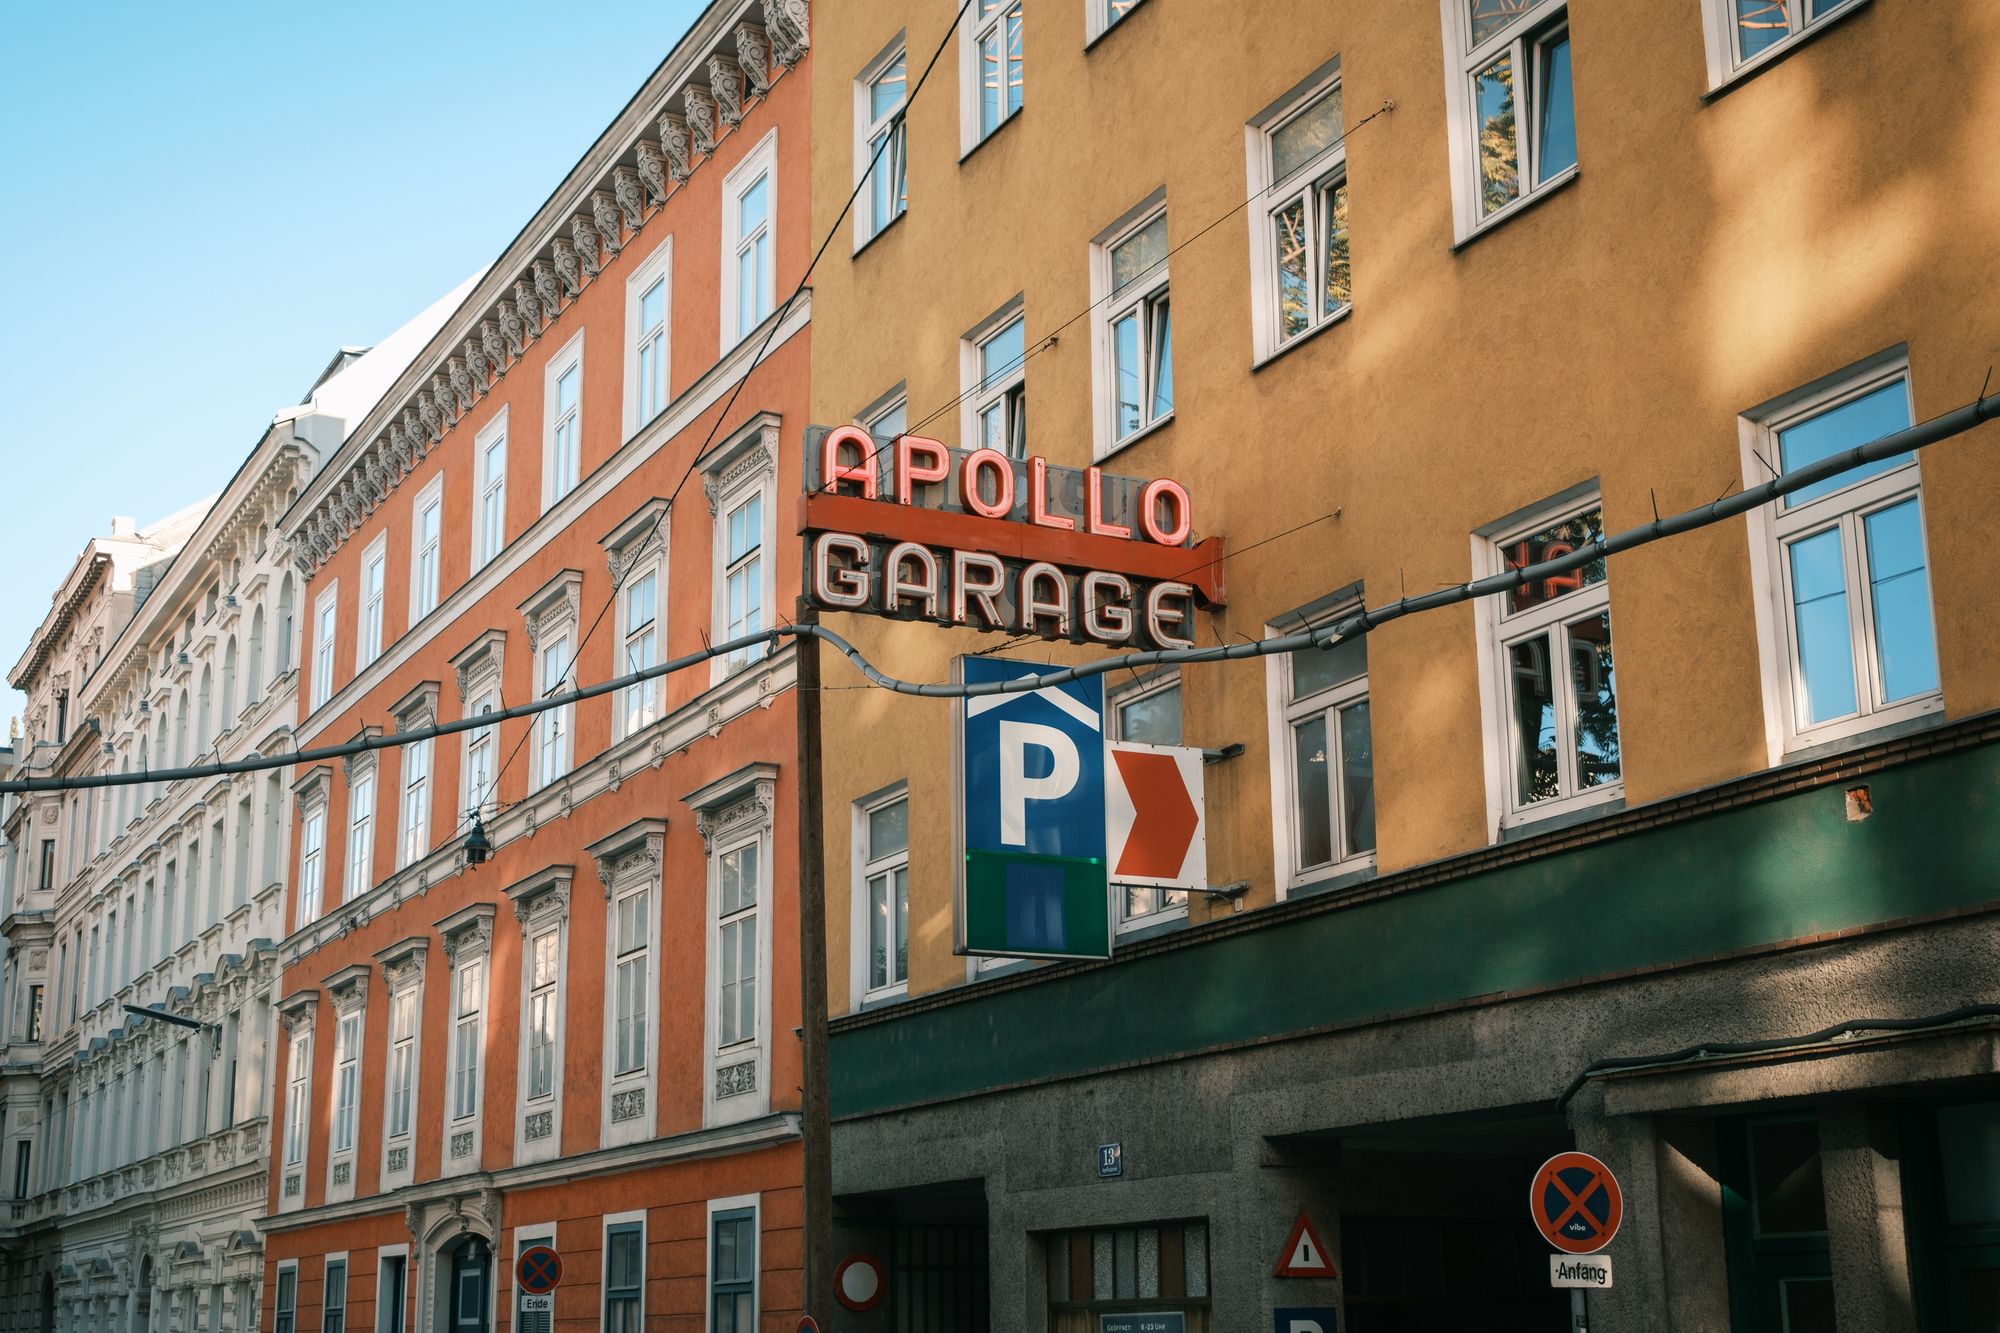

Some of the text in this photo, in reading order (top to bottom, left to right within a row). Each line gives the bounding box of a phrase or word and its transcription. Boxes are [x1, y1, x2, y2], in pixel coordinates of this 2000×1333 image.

[820, 424, 1191, 546] APOLLO
[812, 531, 1195, 649] GARAGE
[1000, 720, 1080, 846] P
[1103, 1148, 1115, 1166] 13
[527, 1299, 548, 1309] Ende
[1558, 1262, 1606, 1285] Anfang
